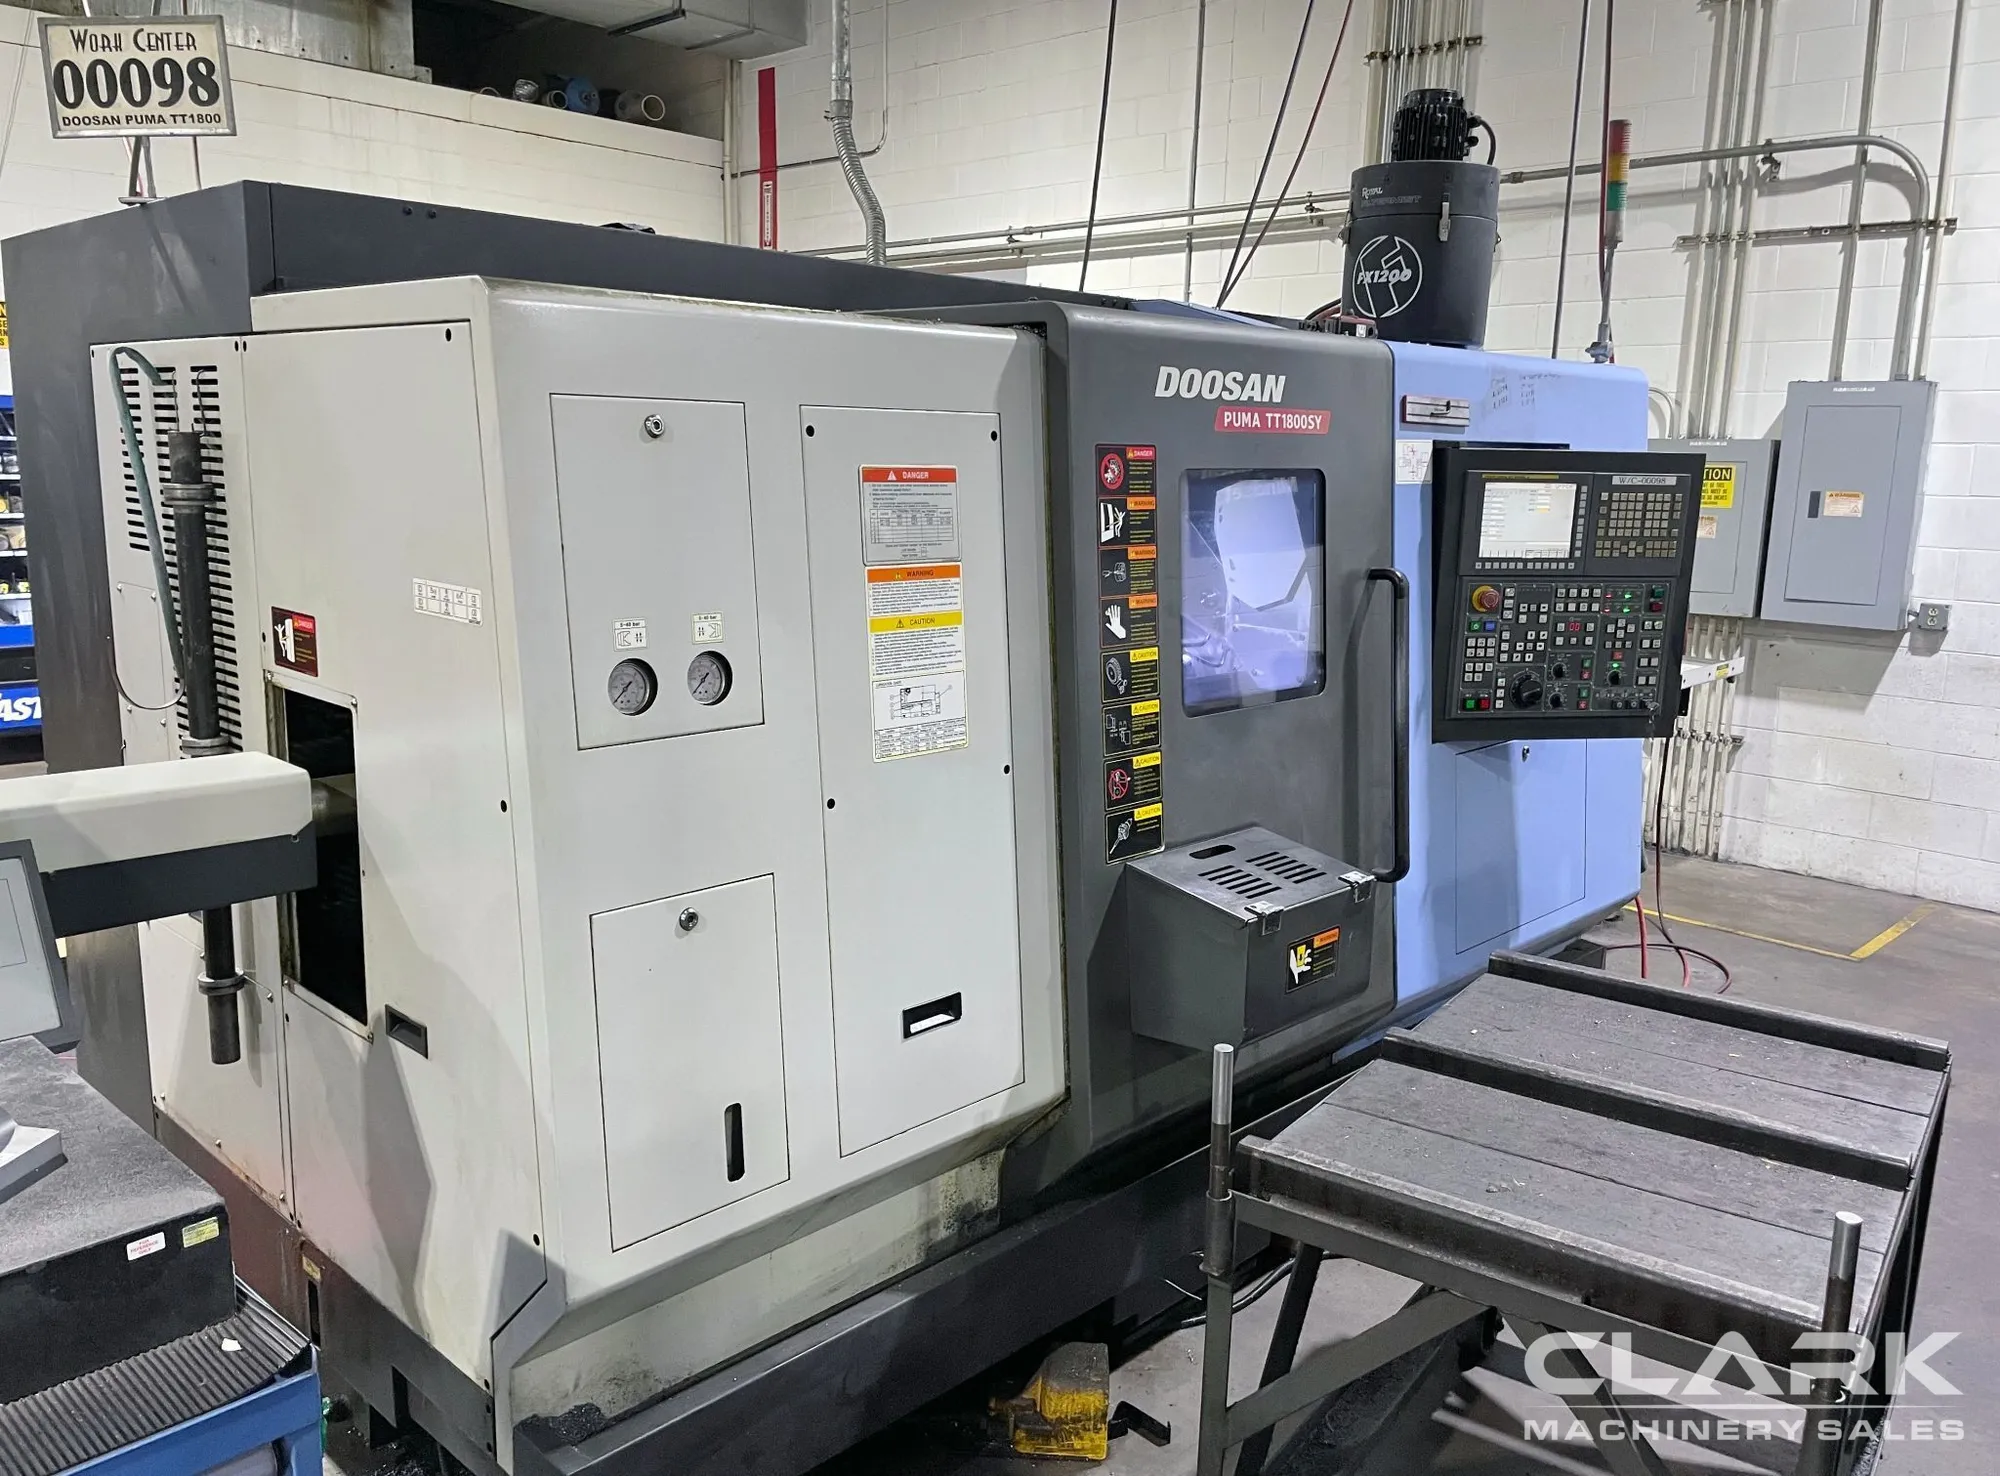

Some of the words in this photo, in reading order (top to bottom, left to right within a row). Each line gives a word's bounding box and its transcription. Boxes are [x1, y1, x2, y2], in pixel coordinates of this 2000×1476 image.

[70, 29, 123, 53] WORK
[132, 28, 197, 52] CENTER
[53, 56, 220, 109] 00098
[62, 115, 121, 127] DOOSAN
[125, 114, 167, 125] PUMA
[169, 113, 221, 124] TT1800
[1154, 365, 1286, 402] DOOSAN
[1223, 411, 1261, 428] PUMA
[1265, 412, 1322, 430] TT1800SY
[902, 471, 929, 479] DANGER
[906, 569, 934, 577] WARNING
[909, 618, 935, 626] CAUTION
